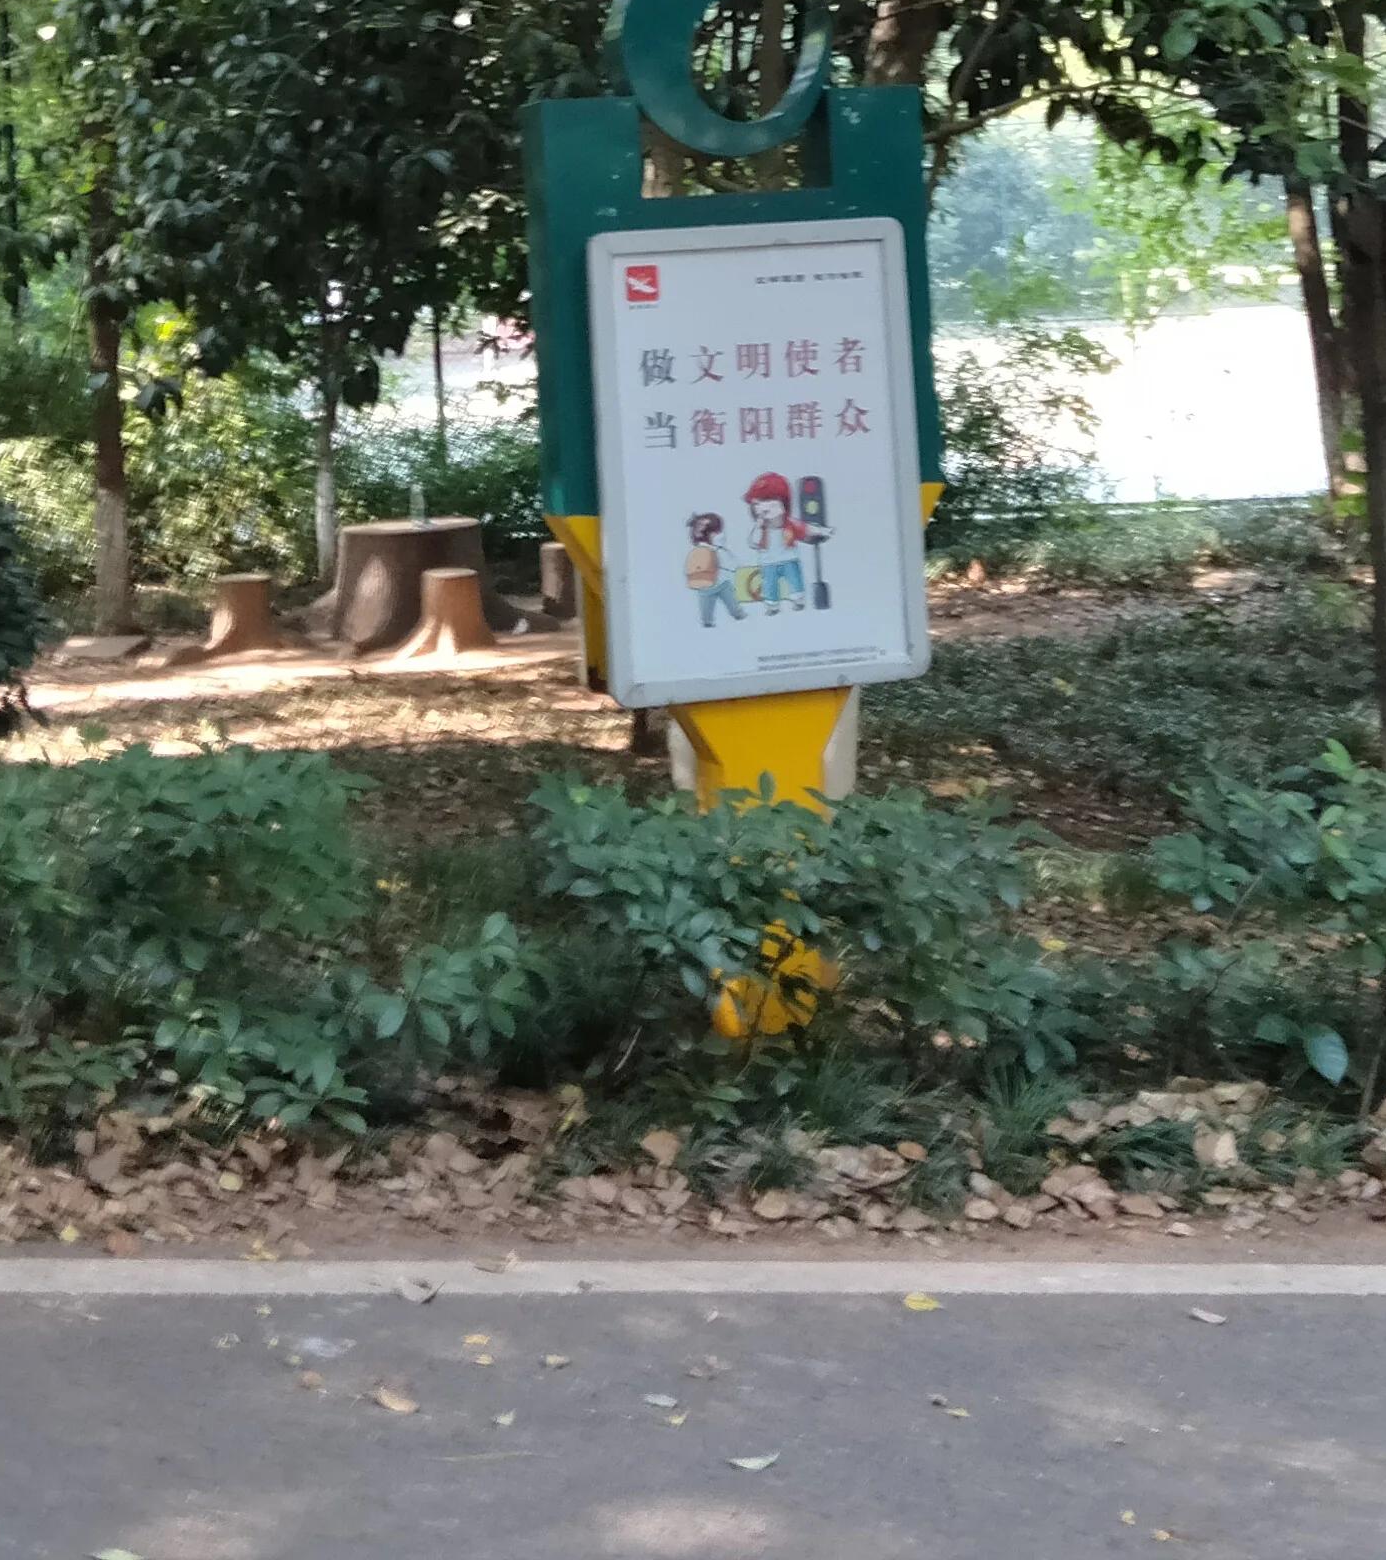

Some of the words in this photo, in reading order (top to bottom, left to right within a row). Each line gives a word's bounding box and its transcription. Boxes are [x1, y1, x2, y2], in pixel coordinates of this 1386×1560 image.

[639, 337, 866, 387] 做文明使者
[644, 397, 871, 449] 当衡阳群众
